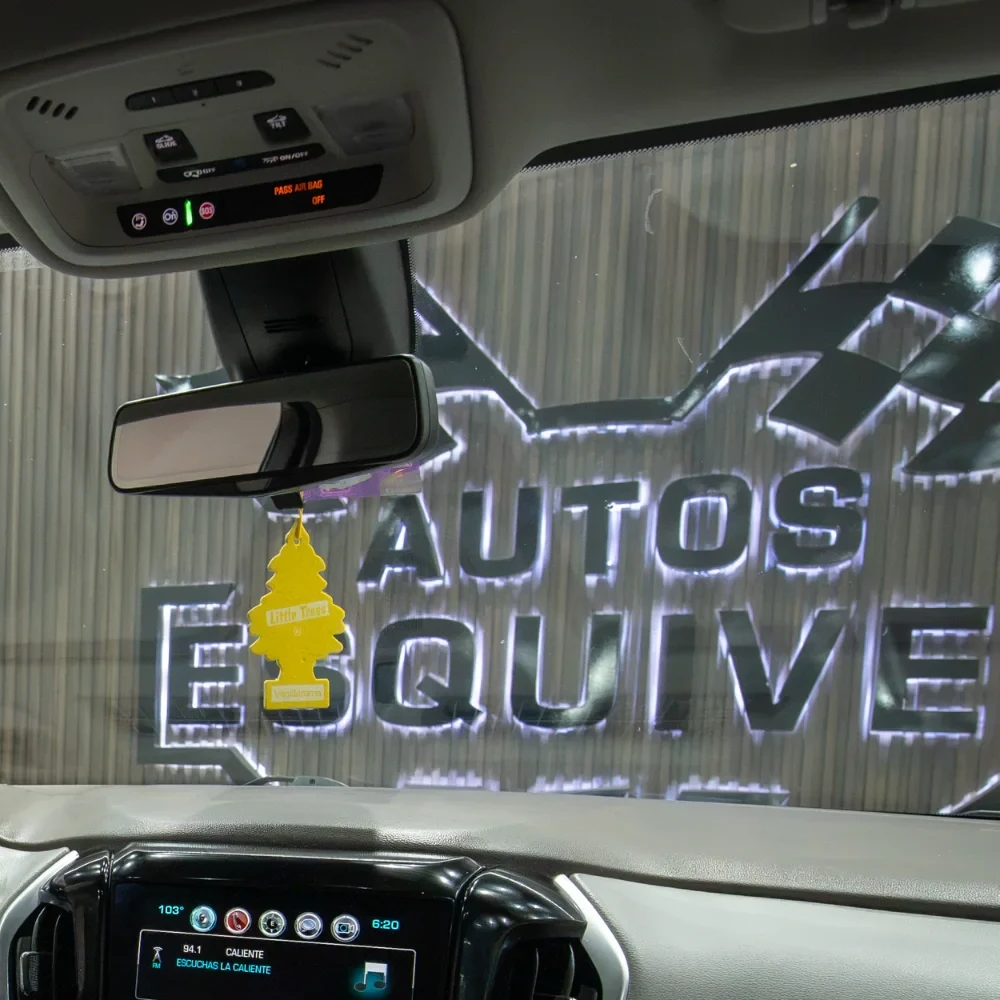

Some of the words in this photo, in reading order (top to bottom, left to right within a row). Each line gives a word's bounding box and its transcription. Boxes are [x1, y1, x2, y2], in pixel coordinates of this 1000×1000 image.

[279, 150, 309, 162] ON/OFF
[273, 184, 294, 196] PASS
[294, 181, 308, 193] AIR
[307, 178, 324, 192] BAG
[311, 194, 326, 206] OFF
[357, 466, 868, 584] AUTOS
[268, 608, 298, 626] Little
[299, 602, 328, 619] Trees
[158, 904, 185, 916] 103°
[371, 918, 400, 931] 6:20
[182, 944, 202, 955] 94.1
[225, 947, 265, 960] CALIENTE
[176, 958, 219, 971] ESCUCHAS
[220, 961, 232, 972] LA
[232, 963, 272, 975] CALIENTE
